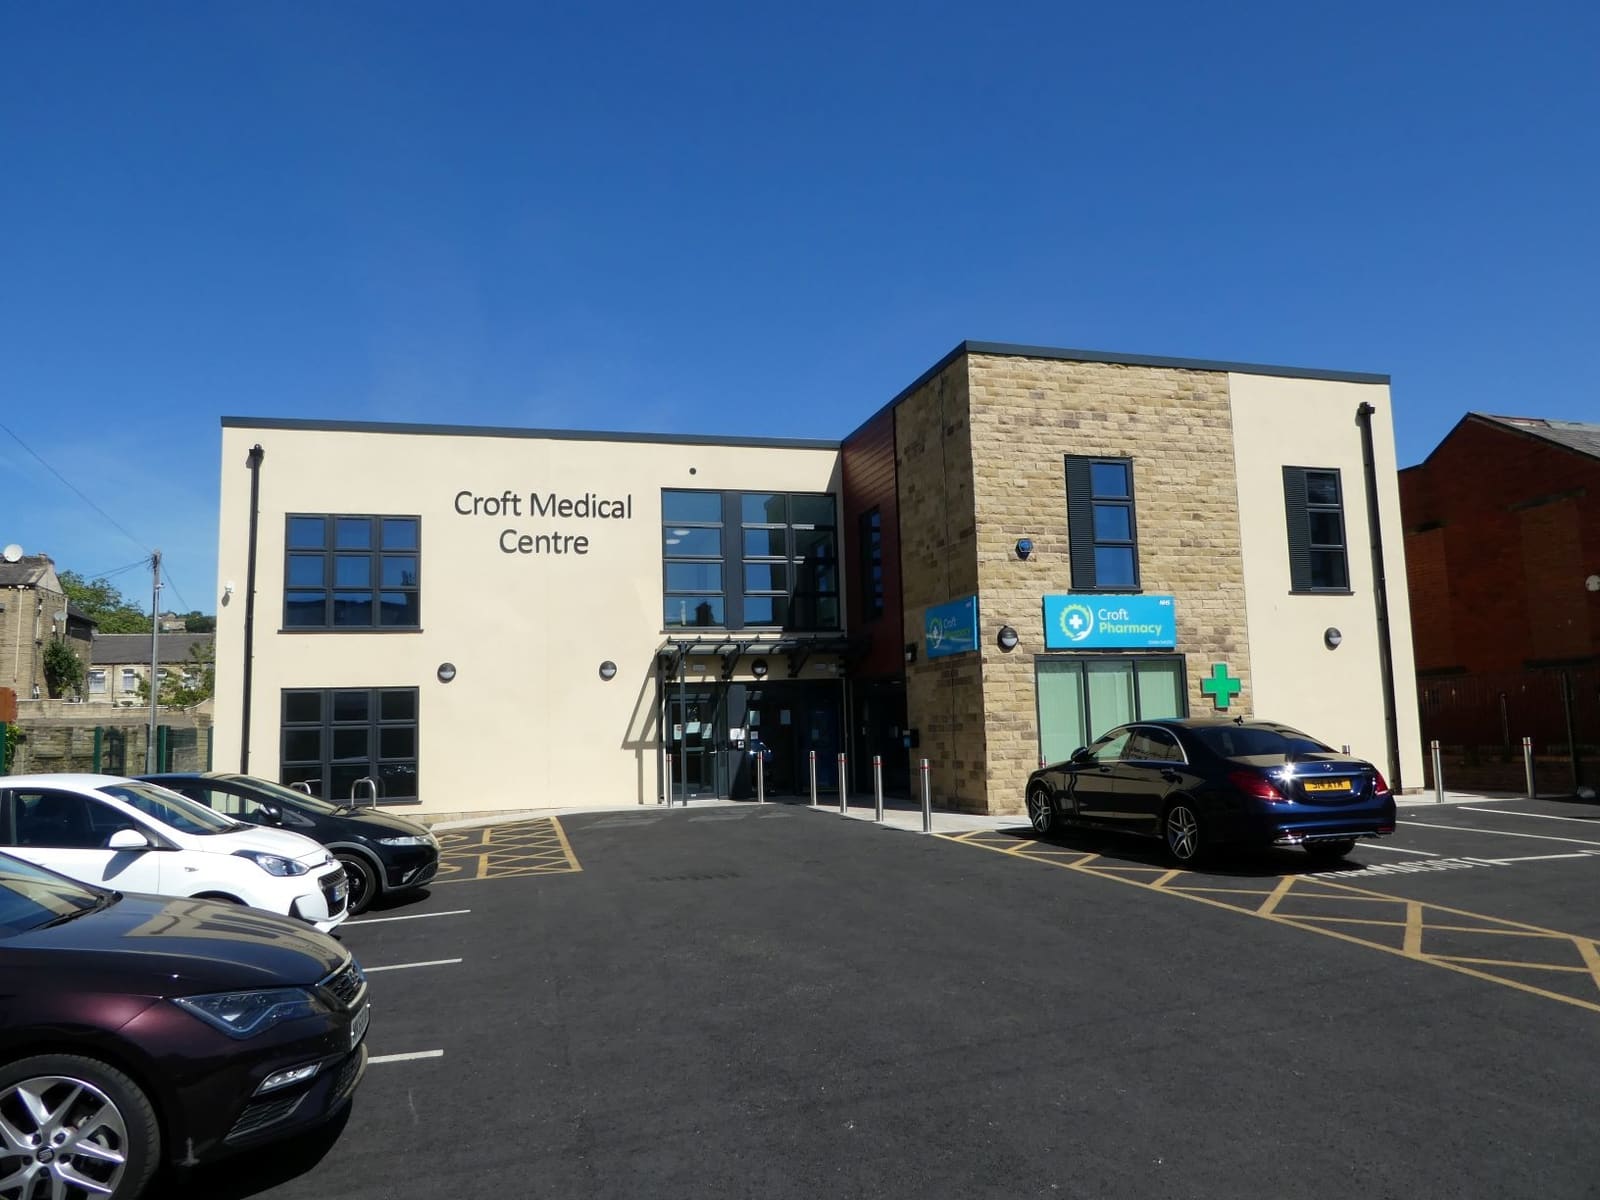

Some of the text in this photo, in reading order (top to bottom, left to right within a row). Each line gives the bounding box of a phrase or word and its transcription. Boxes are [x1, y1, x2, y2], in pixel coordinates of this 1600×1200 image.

[454, 490, 632, 519] Croft Medical
[499, 529, 589, 555] Centre
[1098, 608, 1129, 621] Croft
[1099, 622, 1162, 636] Pharmacy
